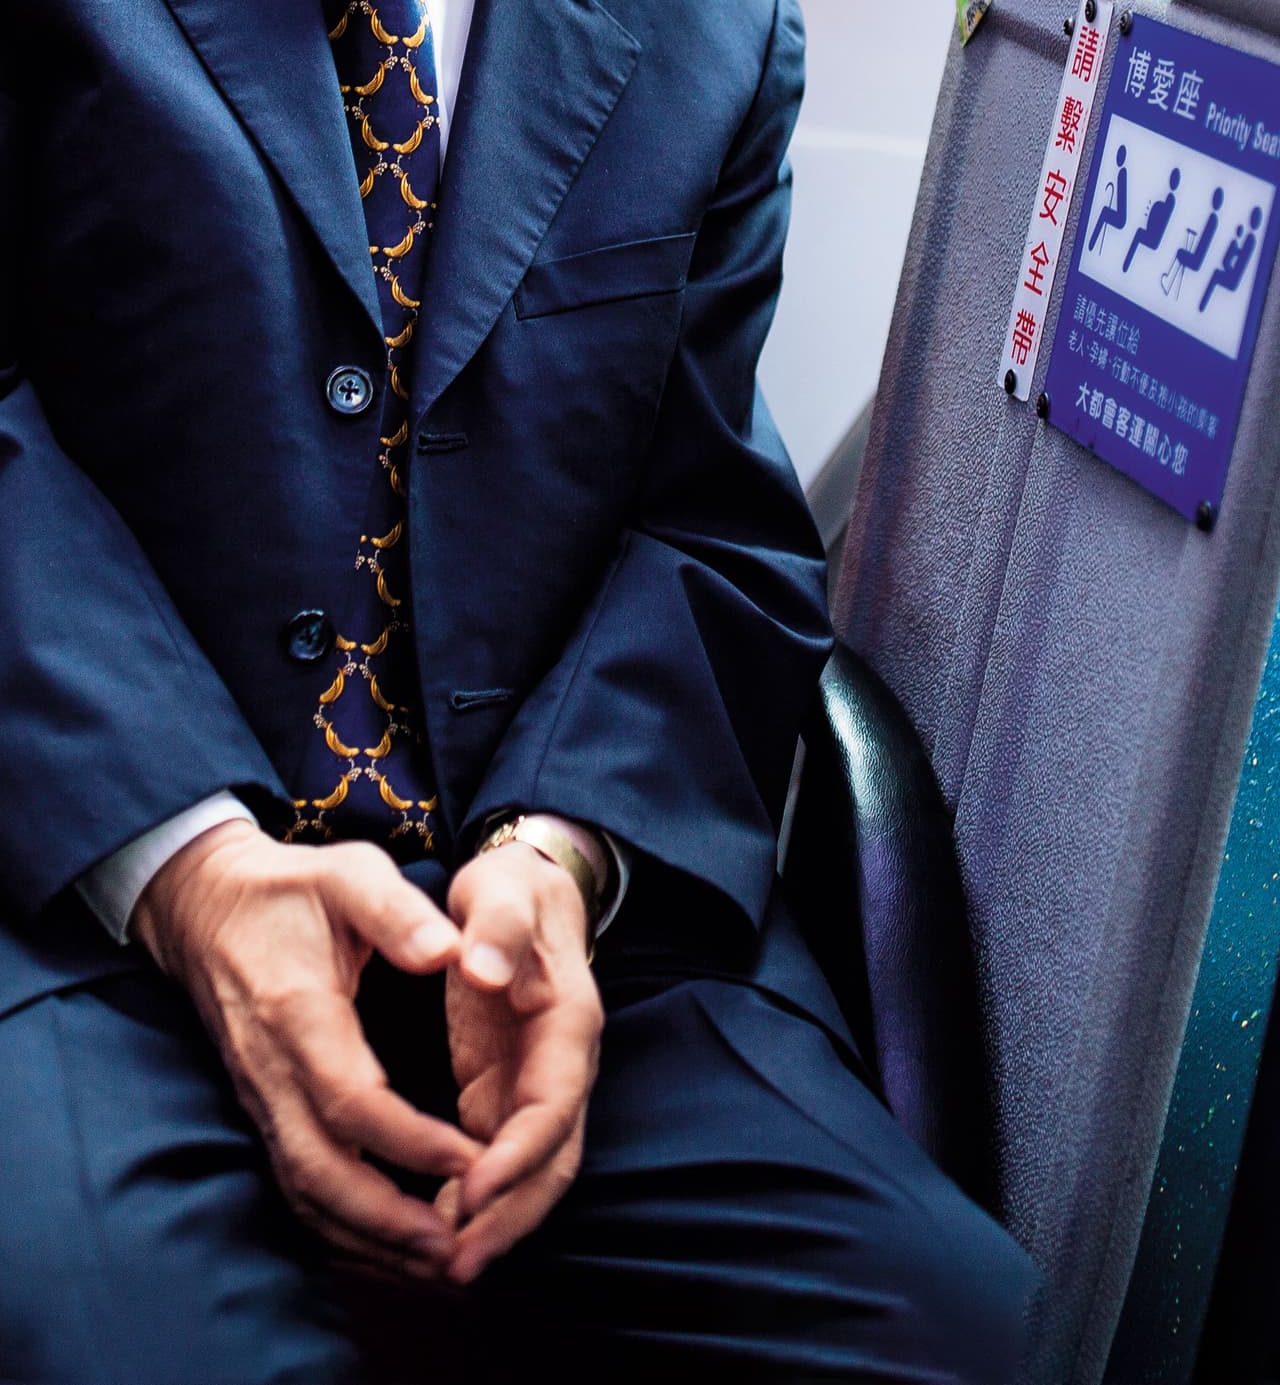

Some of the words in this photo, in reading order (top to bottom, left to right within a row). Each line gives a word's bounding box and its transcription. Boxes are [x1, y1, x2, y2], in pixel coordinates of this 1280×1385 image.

[1124, 46, 1205, 120] 博愛座
[1205, 102, 1253, 152] Priority
[1010, 25, 1100, 366] 請繫安全帶
[1073, 293, 1141, 355] 請優先讓位給
[1075, 381, 1189, 476] 大都會客運關心您
